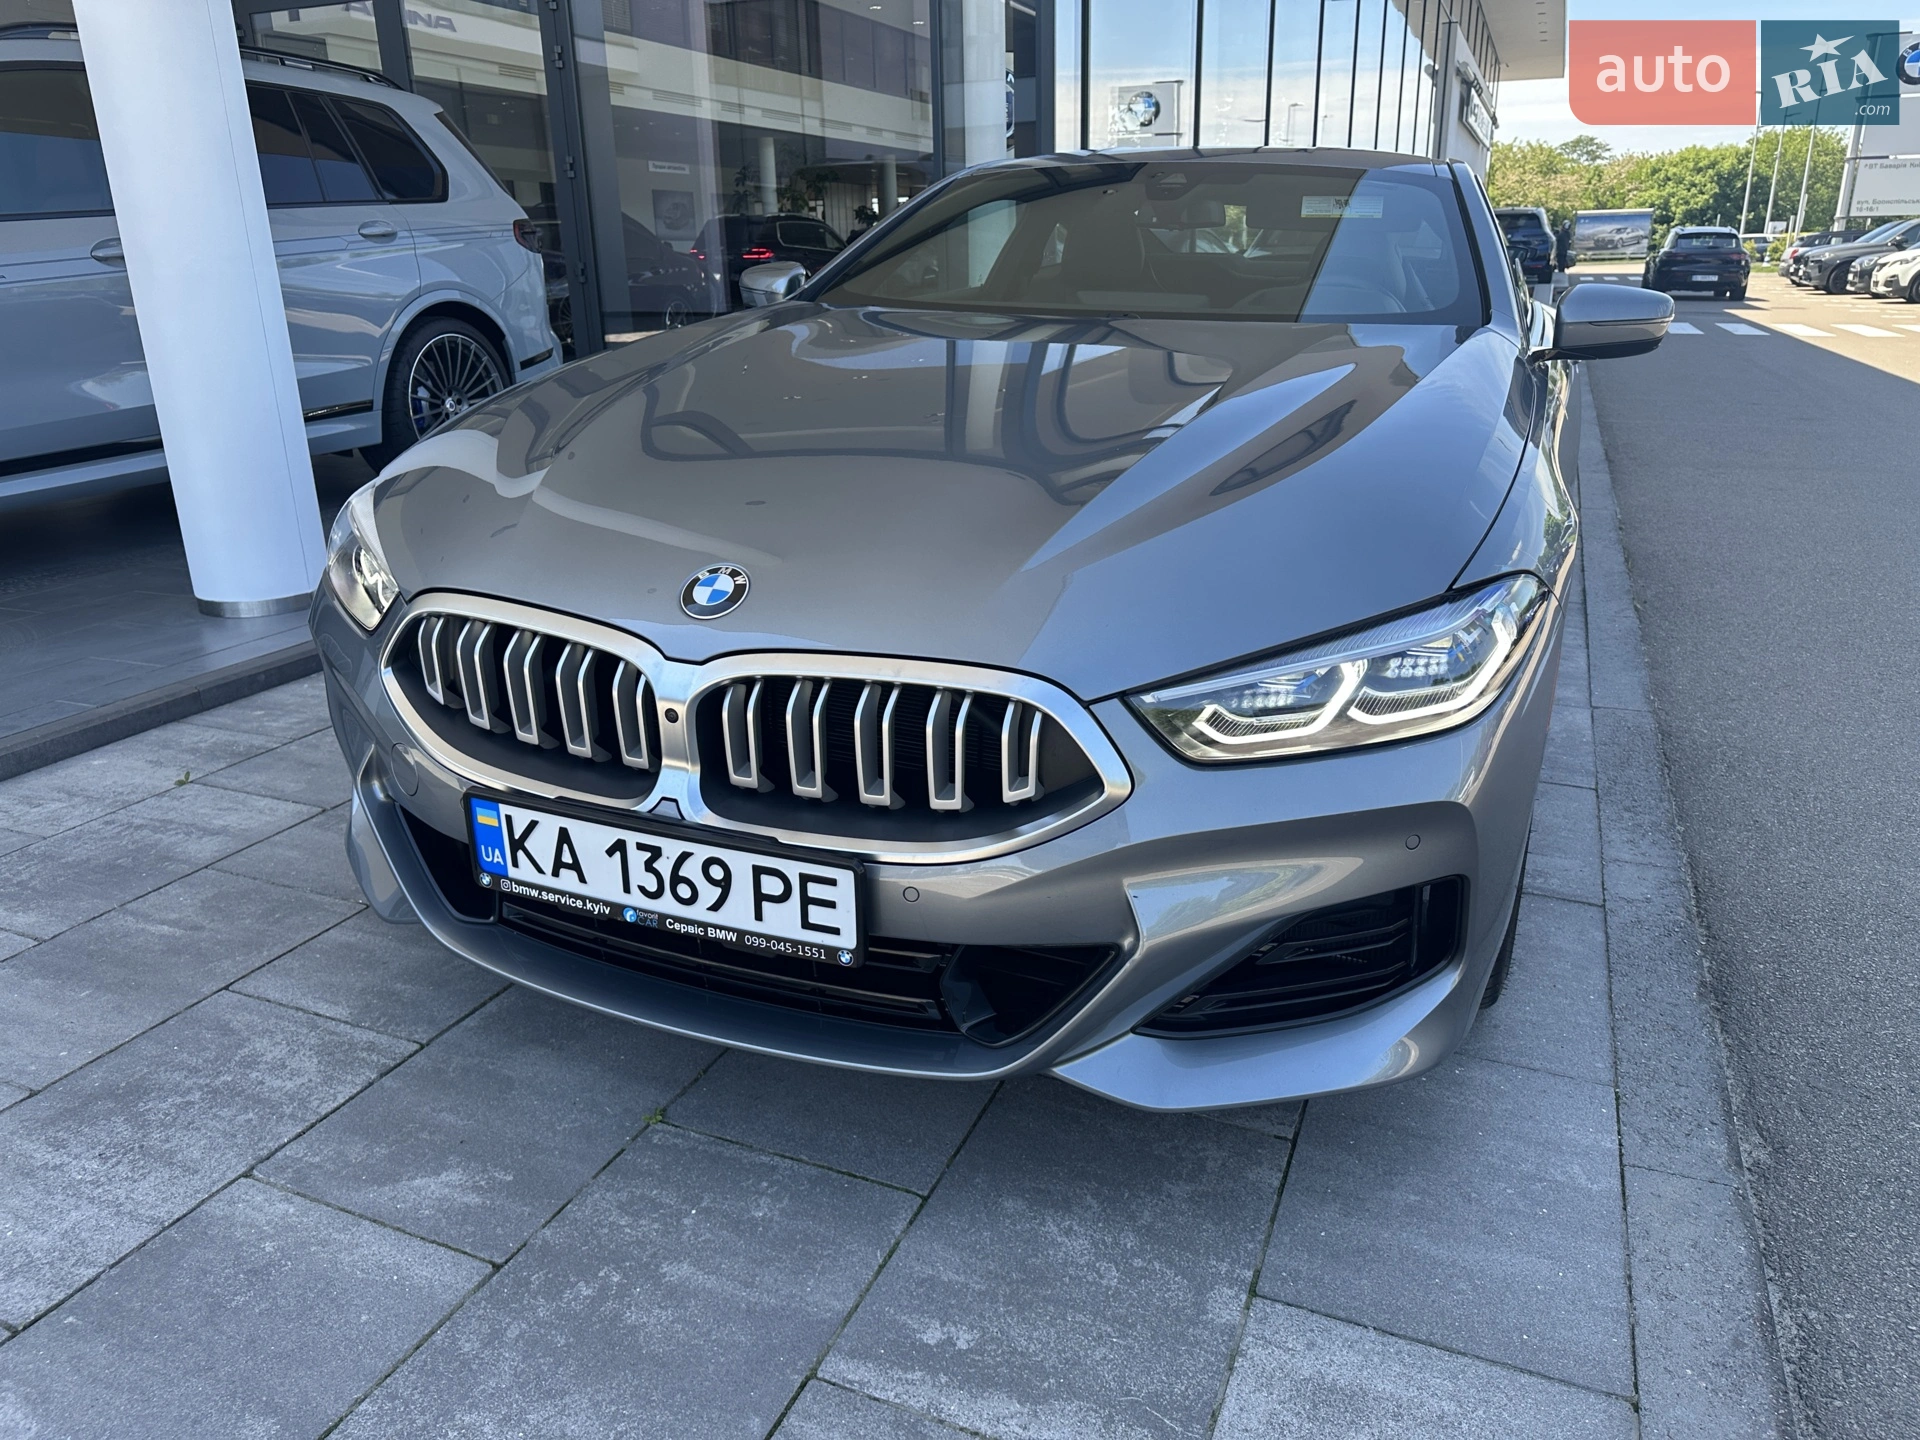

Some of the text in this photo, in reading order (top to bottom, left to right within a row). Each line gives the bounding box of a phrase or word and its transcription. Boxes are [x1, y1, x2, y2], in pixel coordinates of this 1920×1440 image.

[482, 844, 504, 866] UA
[504, 813, 841, 936] KA 1369 PE
[512, 881, 611, 915] bmw.service.kyiv
[637, 916, 658, 929] CAR
[665, 918, 705, 936] Сервіс
[707, 927, 738, 942] BMW
[744, 934, 827, 960] 099-045-1551
